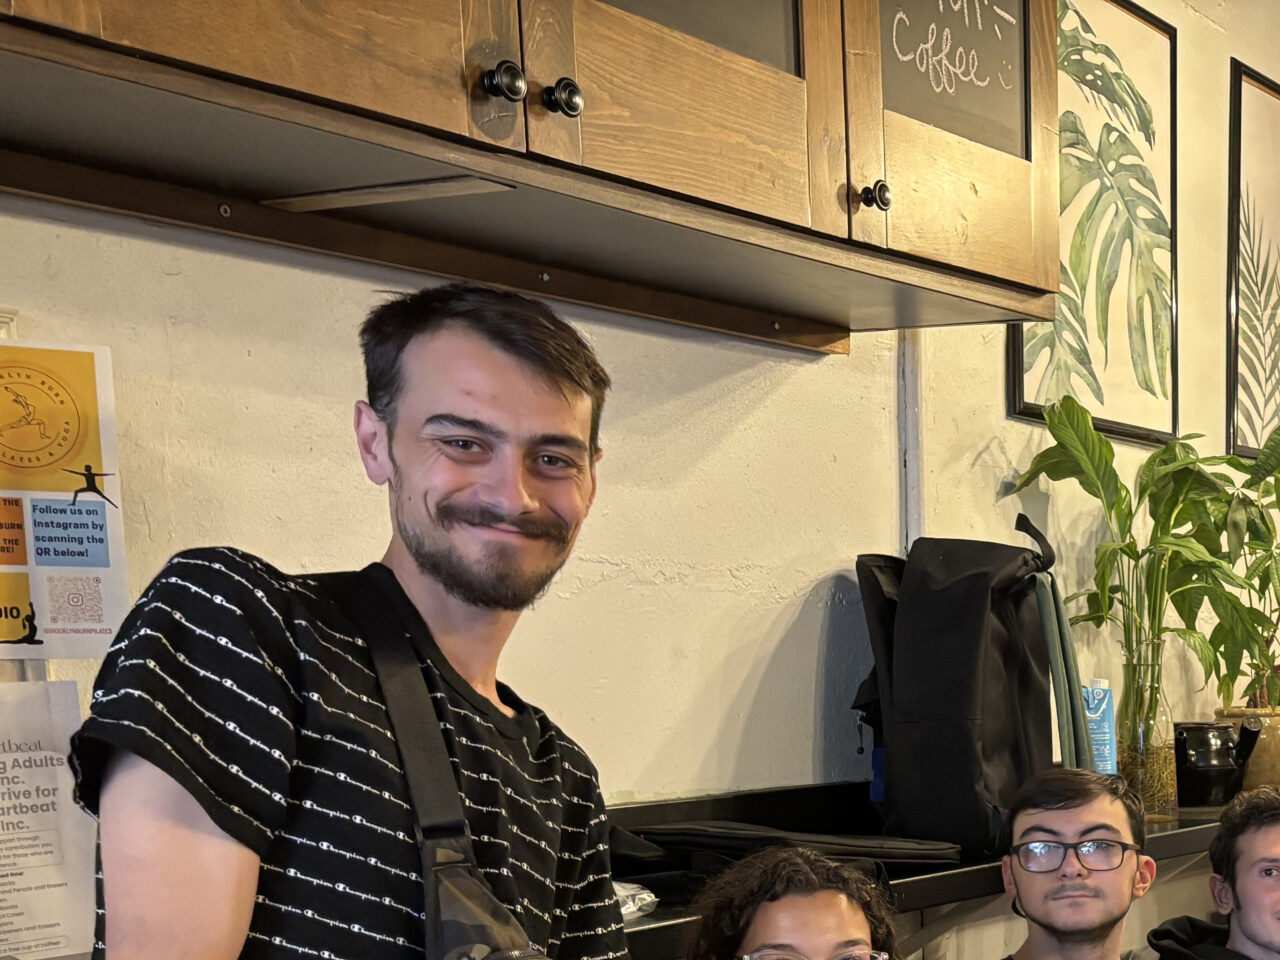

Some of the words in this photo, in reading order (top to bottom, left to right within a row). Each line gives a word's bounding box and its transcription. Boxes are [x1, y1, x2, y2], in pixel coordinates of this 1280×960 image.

[893, 11, 990, 93] Coffee
[32, 505, 67, 514] Follow
[70, 507, 83, 515] us
[34, 520, 89, 530] Instagram
[92, 522, 104, 531] by
[35, 535, 84, 545] scanning
[36, 547, 51, 556] QR
[54, 548, 89, 557] below!
[11, 756, 64, 770] Adults
[35, 785, 58, 798] for
